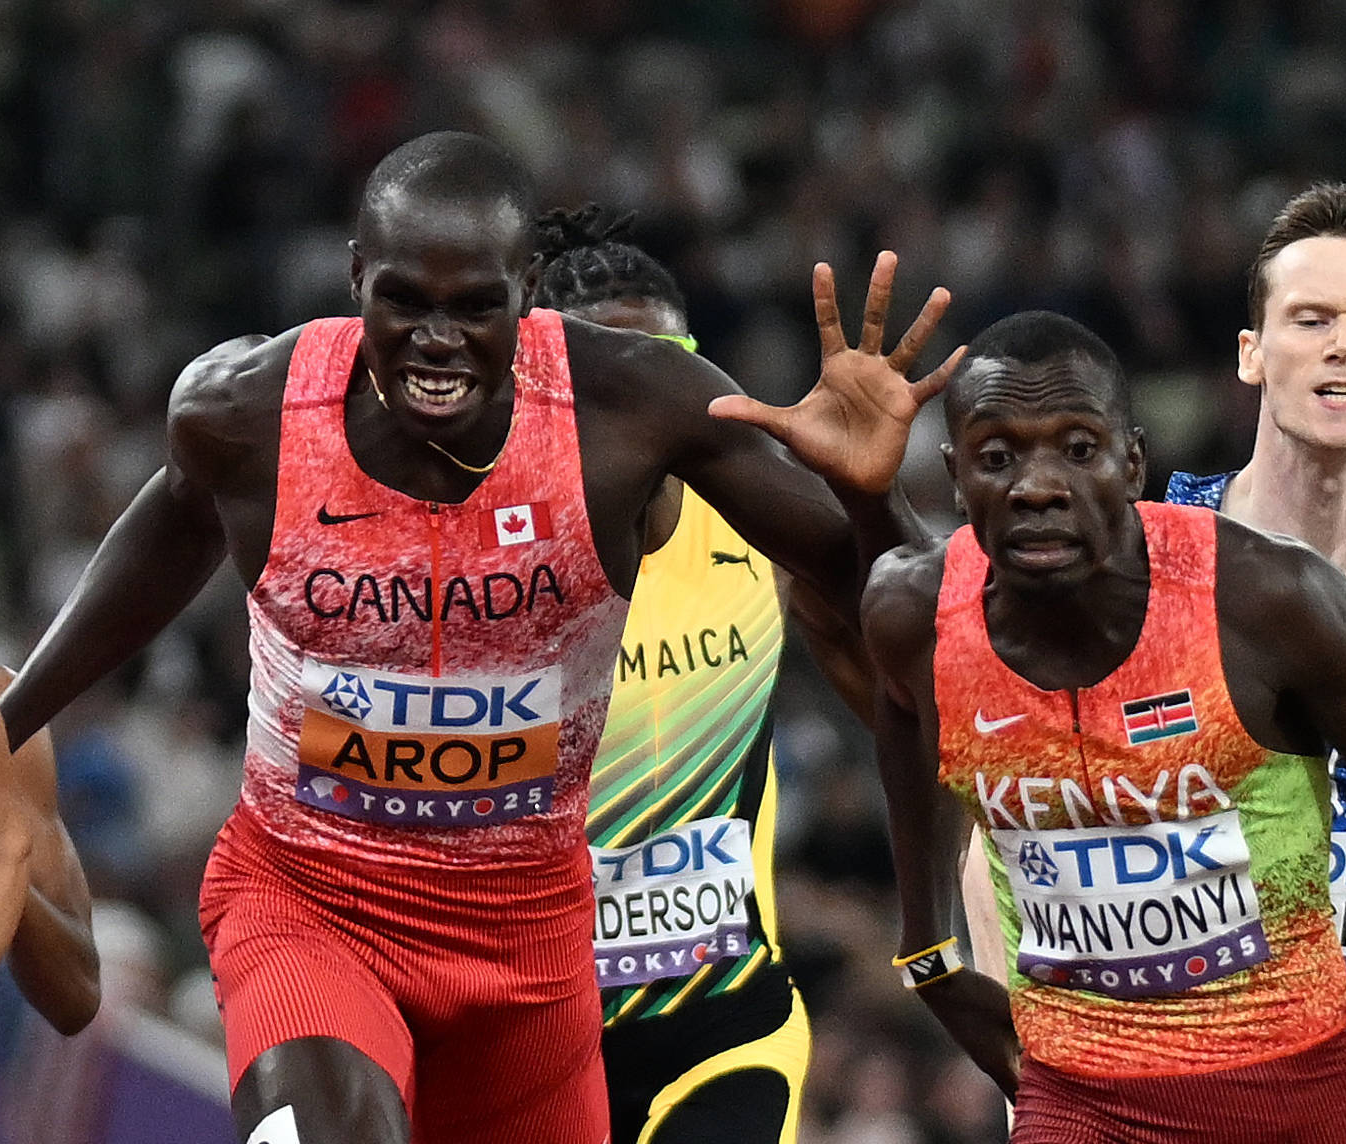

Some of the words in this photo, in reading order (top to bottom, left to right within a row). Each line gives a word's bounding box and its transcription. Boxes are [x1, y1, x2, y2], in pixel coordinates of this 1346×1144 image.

[304, 564, 564, 624] CANADA
[373, 677, 542, 728] TDK
[331, 732, 527, 786] AROP
[974, 763, 1231, 830] KENYA
[598, 822, 739, 882] TDK
[1053, 825, 1223, 888] TDK
[593, 876, 747, 941] DERSON
[1023, 875, 1249, 954] WANYONYI
